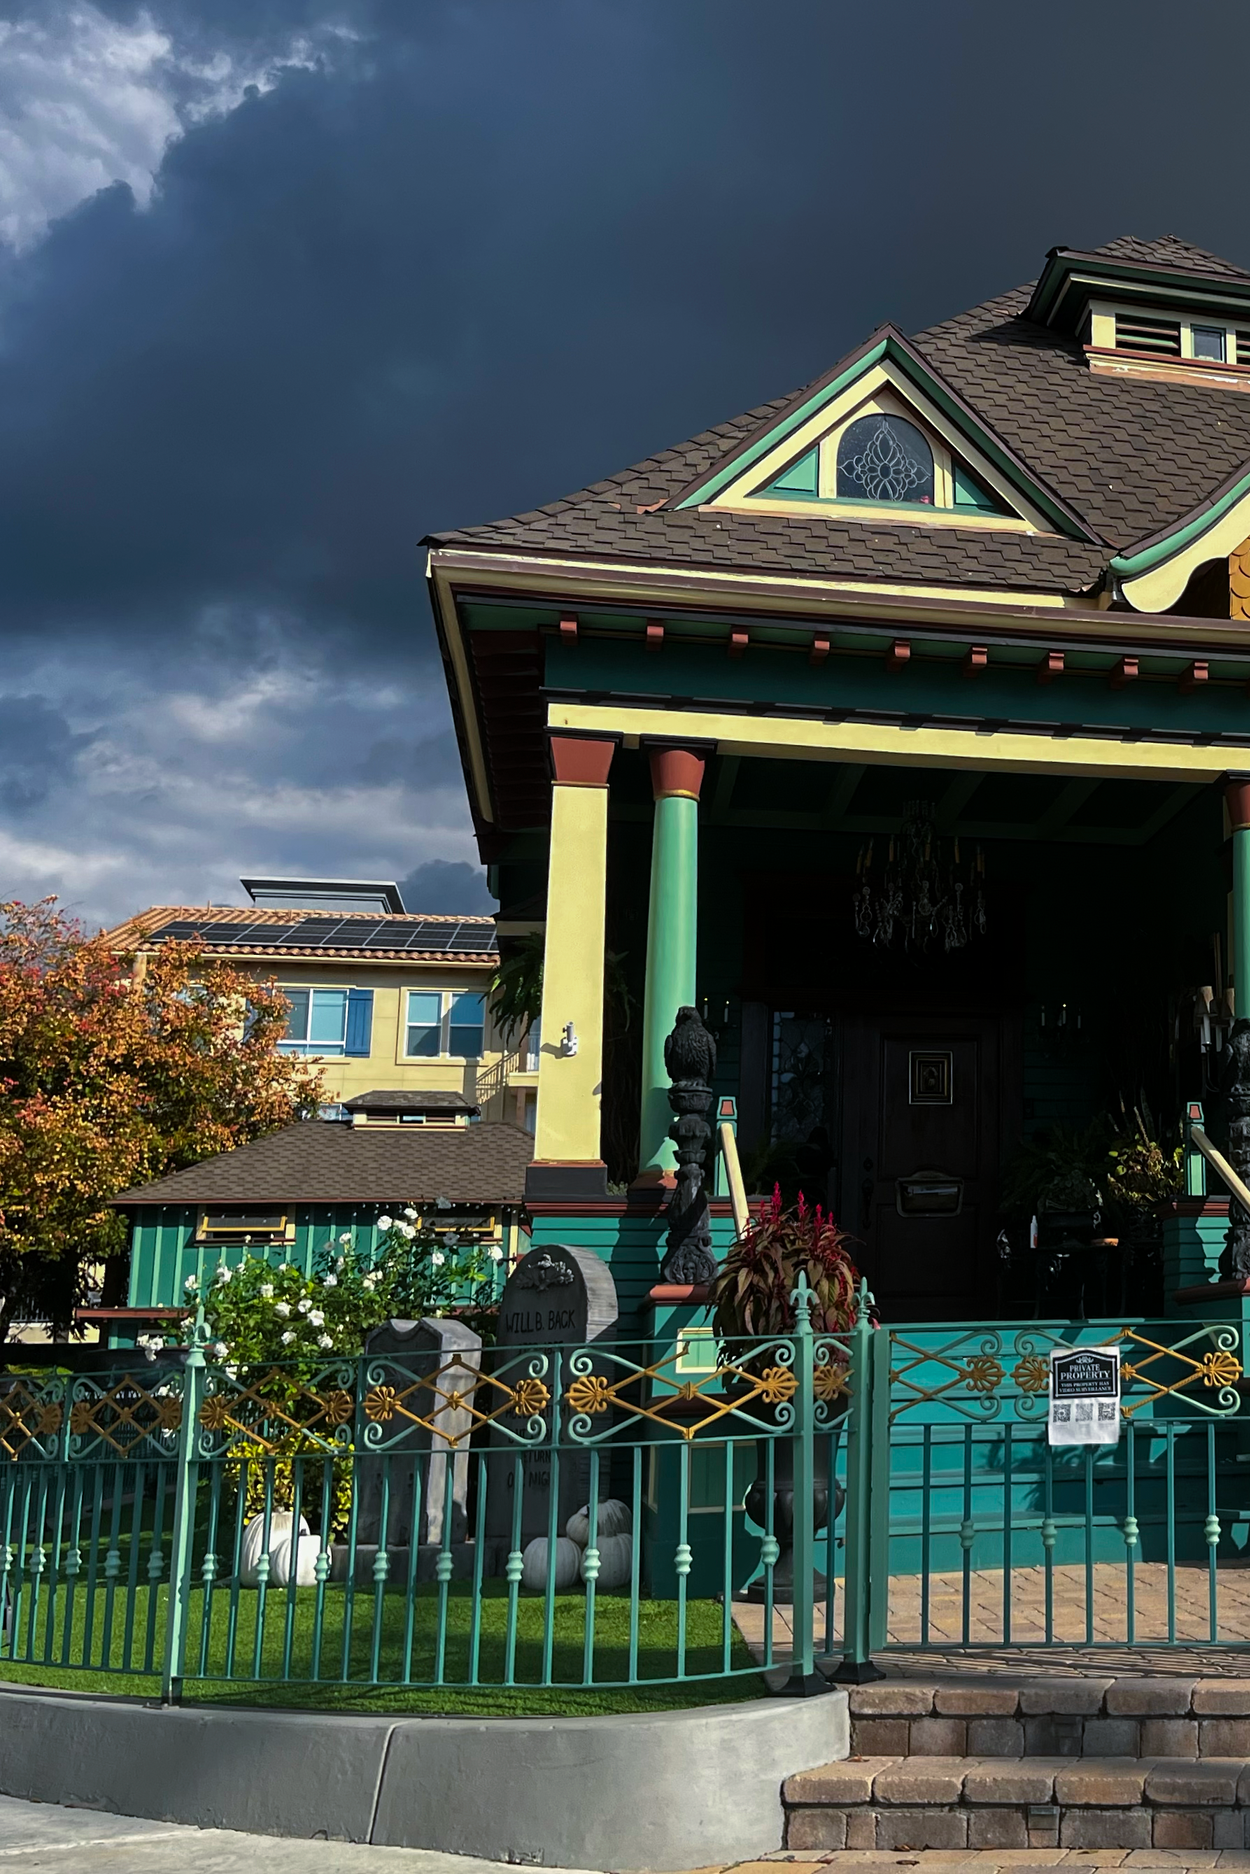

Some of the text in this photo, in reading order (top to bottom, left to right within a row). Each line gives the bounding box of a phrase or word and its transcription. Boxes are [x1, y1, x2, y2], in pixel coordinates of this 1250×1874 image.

[505, 1309, 576, 1333] WILL B. BACK
[1069, 1364, 1101, 1372] PRIVATE
[1060, 1371, 1110, 1380] PROPERTY
